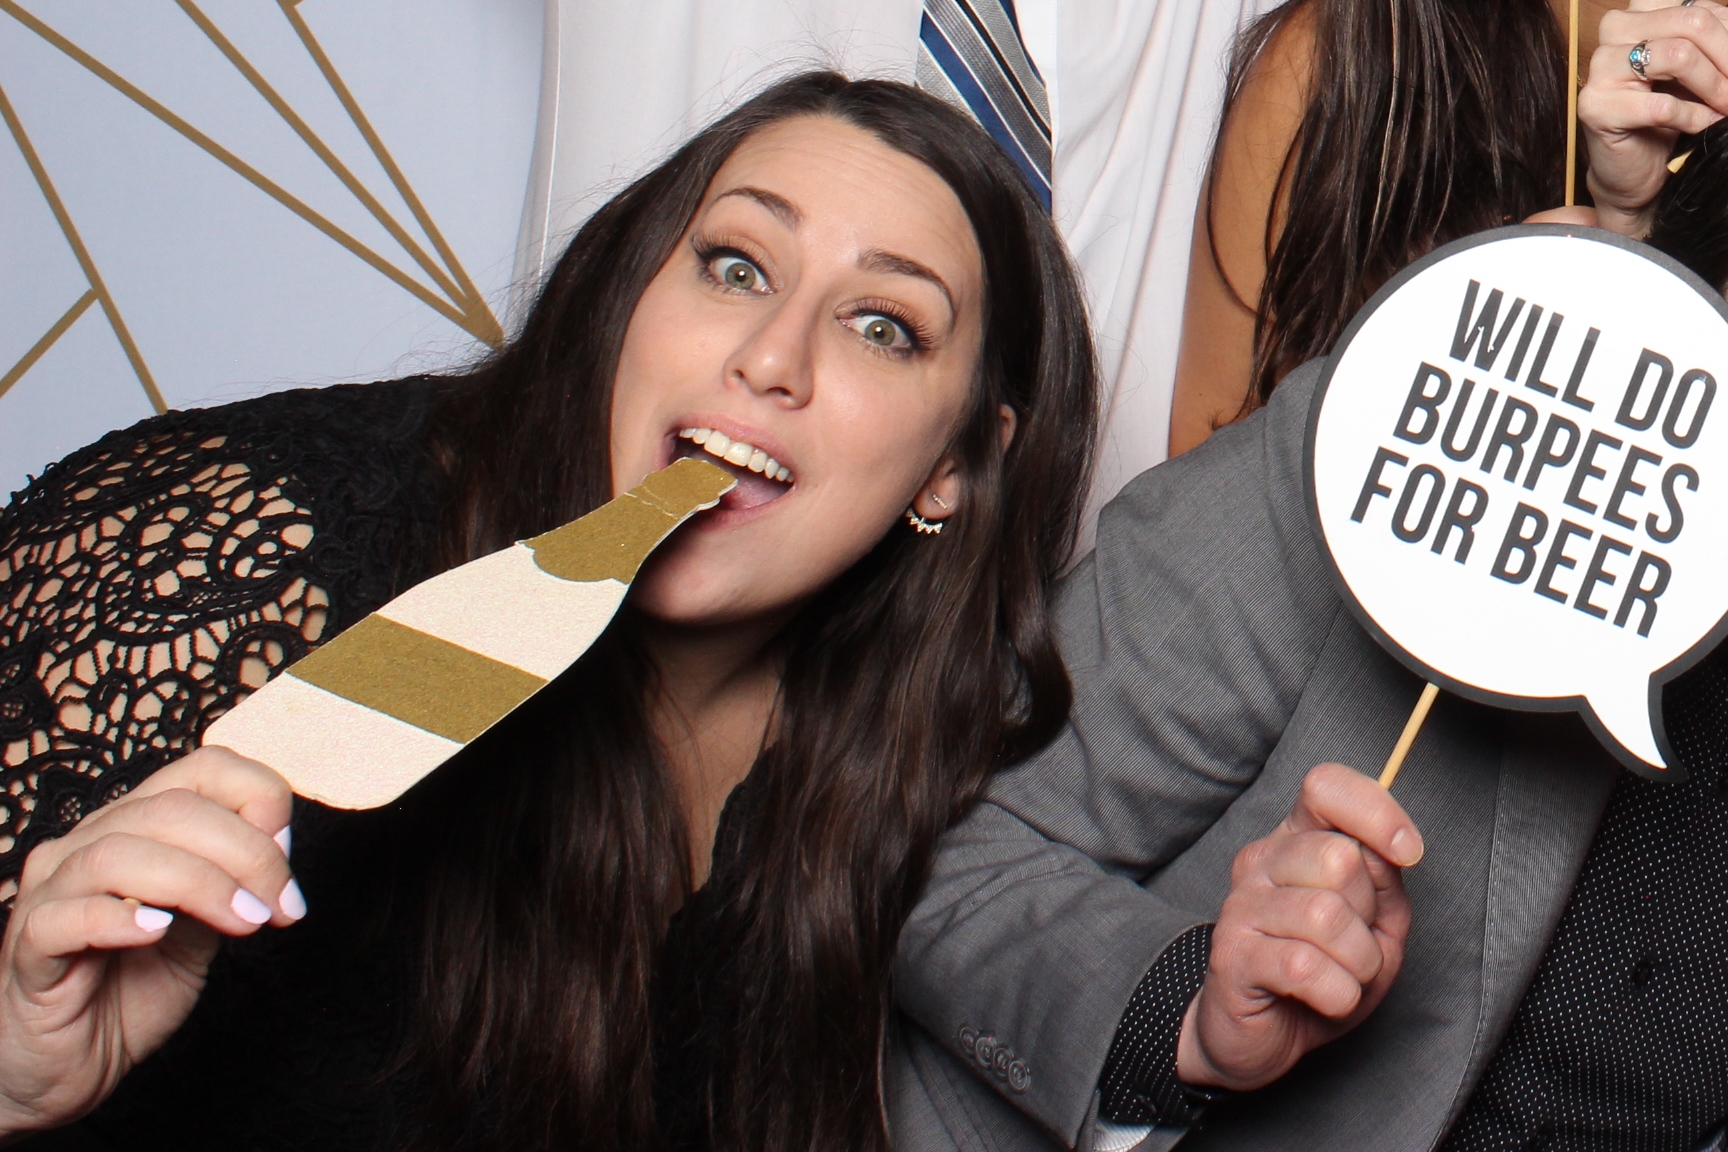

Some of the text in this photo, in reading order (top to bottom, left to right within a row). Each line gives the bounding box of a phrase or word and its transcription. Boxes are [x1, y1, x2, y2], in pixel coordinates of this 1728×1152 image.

[1392, 361, 1700, 544] BURPEES
[1449, 279, 1717, 449] WILL DO
[1350, 445, 1672, 638] FOR BEER
